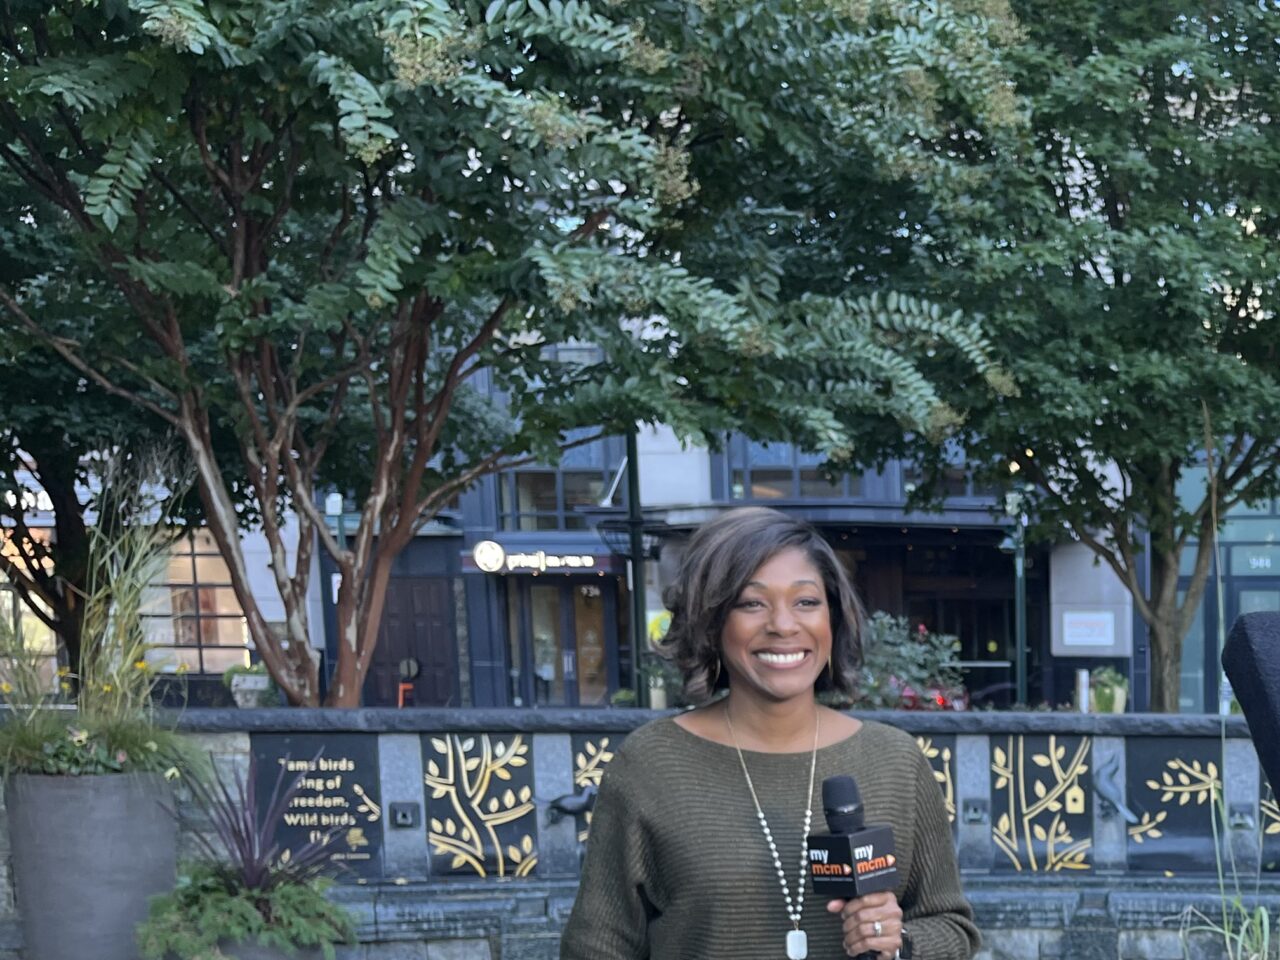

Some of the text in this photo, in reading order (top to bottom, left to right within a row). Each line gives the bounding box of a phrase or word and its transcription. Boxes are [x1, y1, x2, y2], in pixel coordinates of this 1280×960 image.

[319, 757, 355, 772] birds
[326, 775, 342, 790] of
[284, 812, 357, 827] Wild birds
[809, 849, 829, 865] my
[853, 844, 874, 861] my
[812, 863, 843, 876] mcm
[856, 856, 887, 874] mcm
